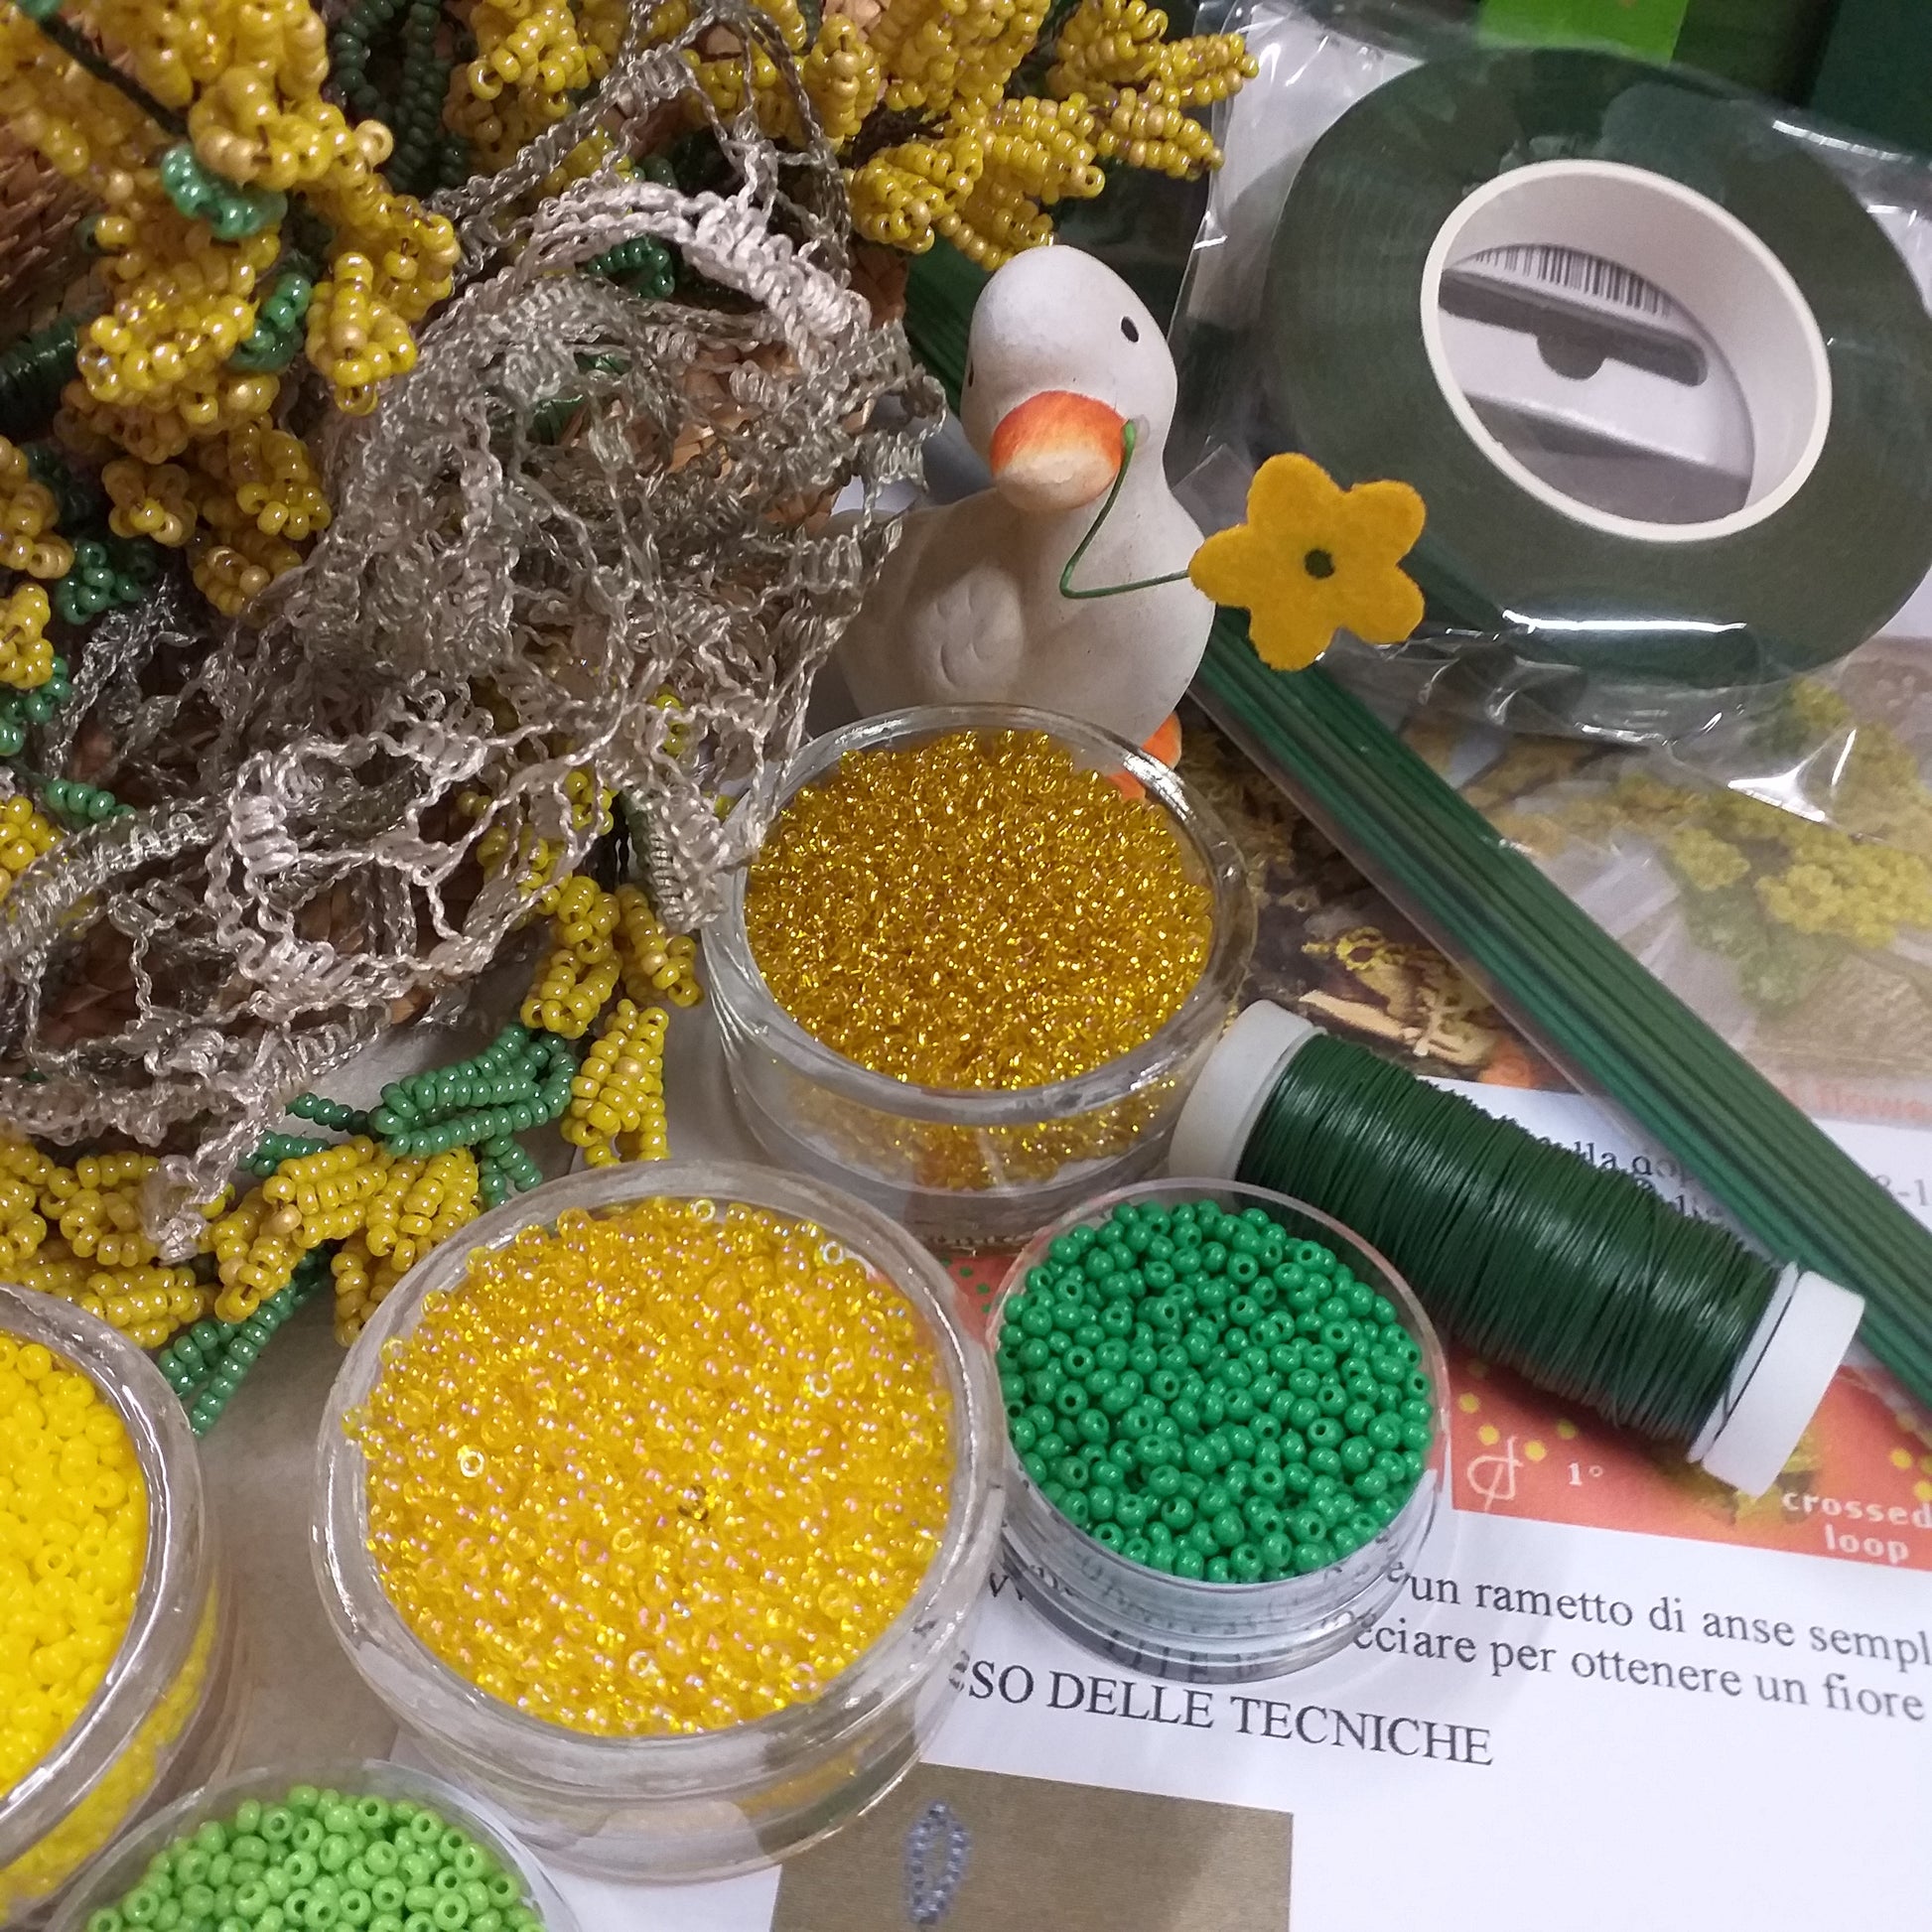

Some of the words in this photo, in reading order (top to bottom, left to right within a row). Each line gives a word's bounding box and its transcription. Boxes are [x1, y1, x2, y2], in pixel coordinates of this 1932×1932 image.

[1781, 1491, 1932, 1529] crossed
[1825, 1523, 1909, 1565] loop
[1410, 1575, 1460, 1605] un
[1475, 1583, 1633, 1627] rametto
[1649, 1596, 1686, 1633] di
[1703, 1609, 1795, 1647] anse
[1809, 1624, 1932, 1674] sempl
[1045, 1670, 1214, 1728] DELLE
[1229, 1695, 1493, 1766] TECNICHE
[1489, 1640, 1558, 1677] per
[1571, 1649, 1742, 1698] ottenere
[1754, 1674, 1808, 1706] un
[1822, 1672, 1925, 1722] fiore
